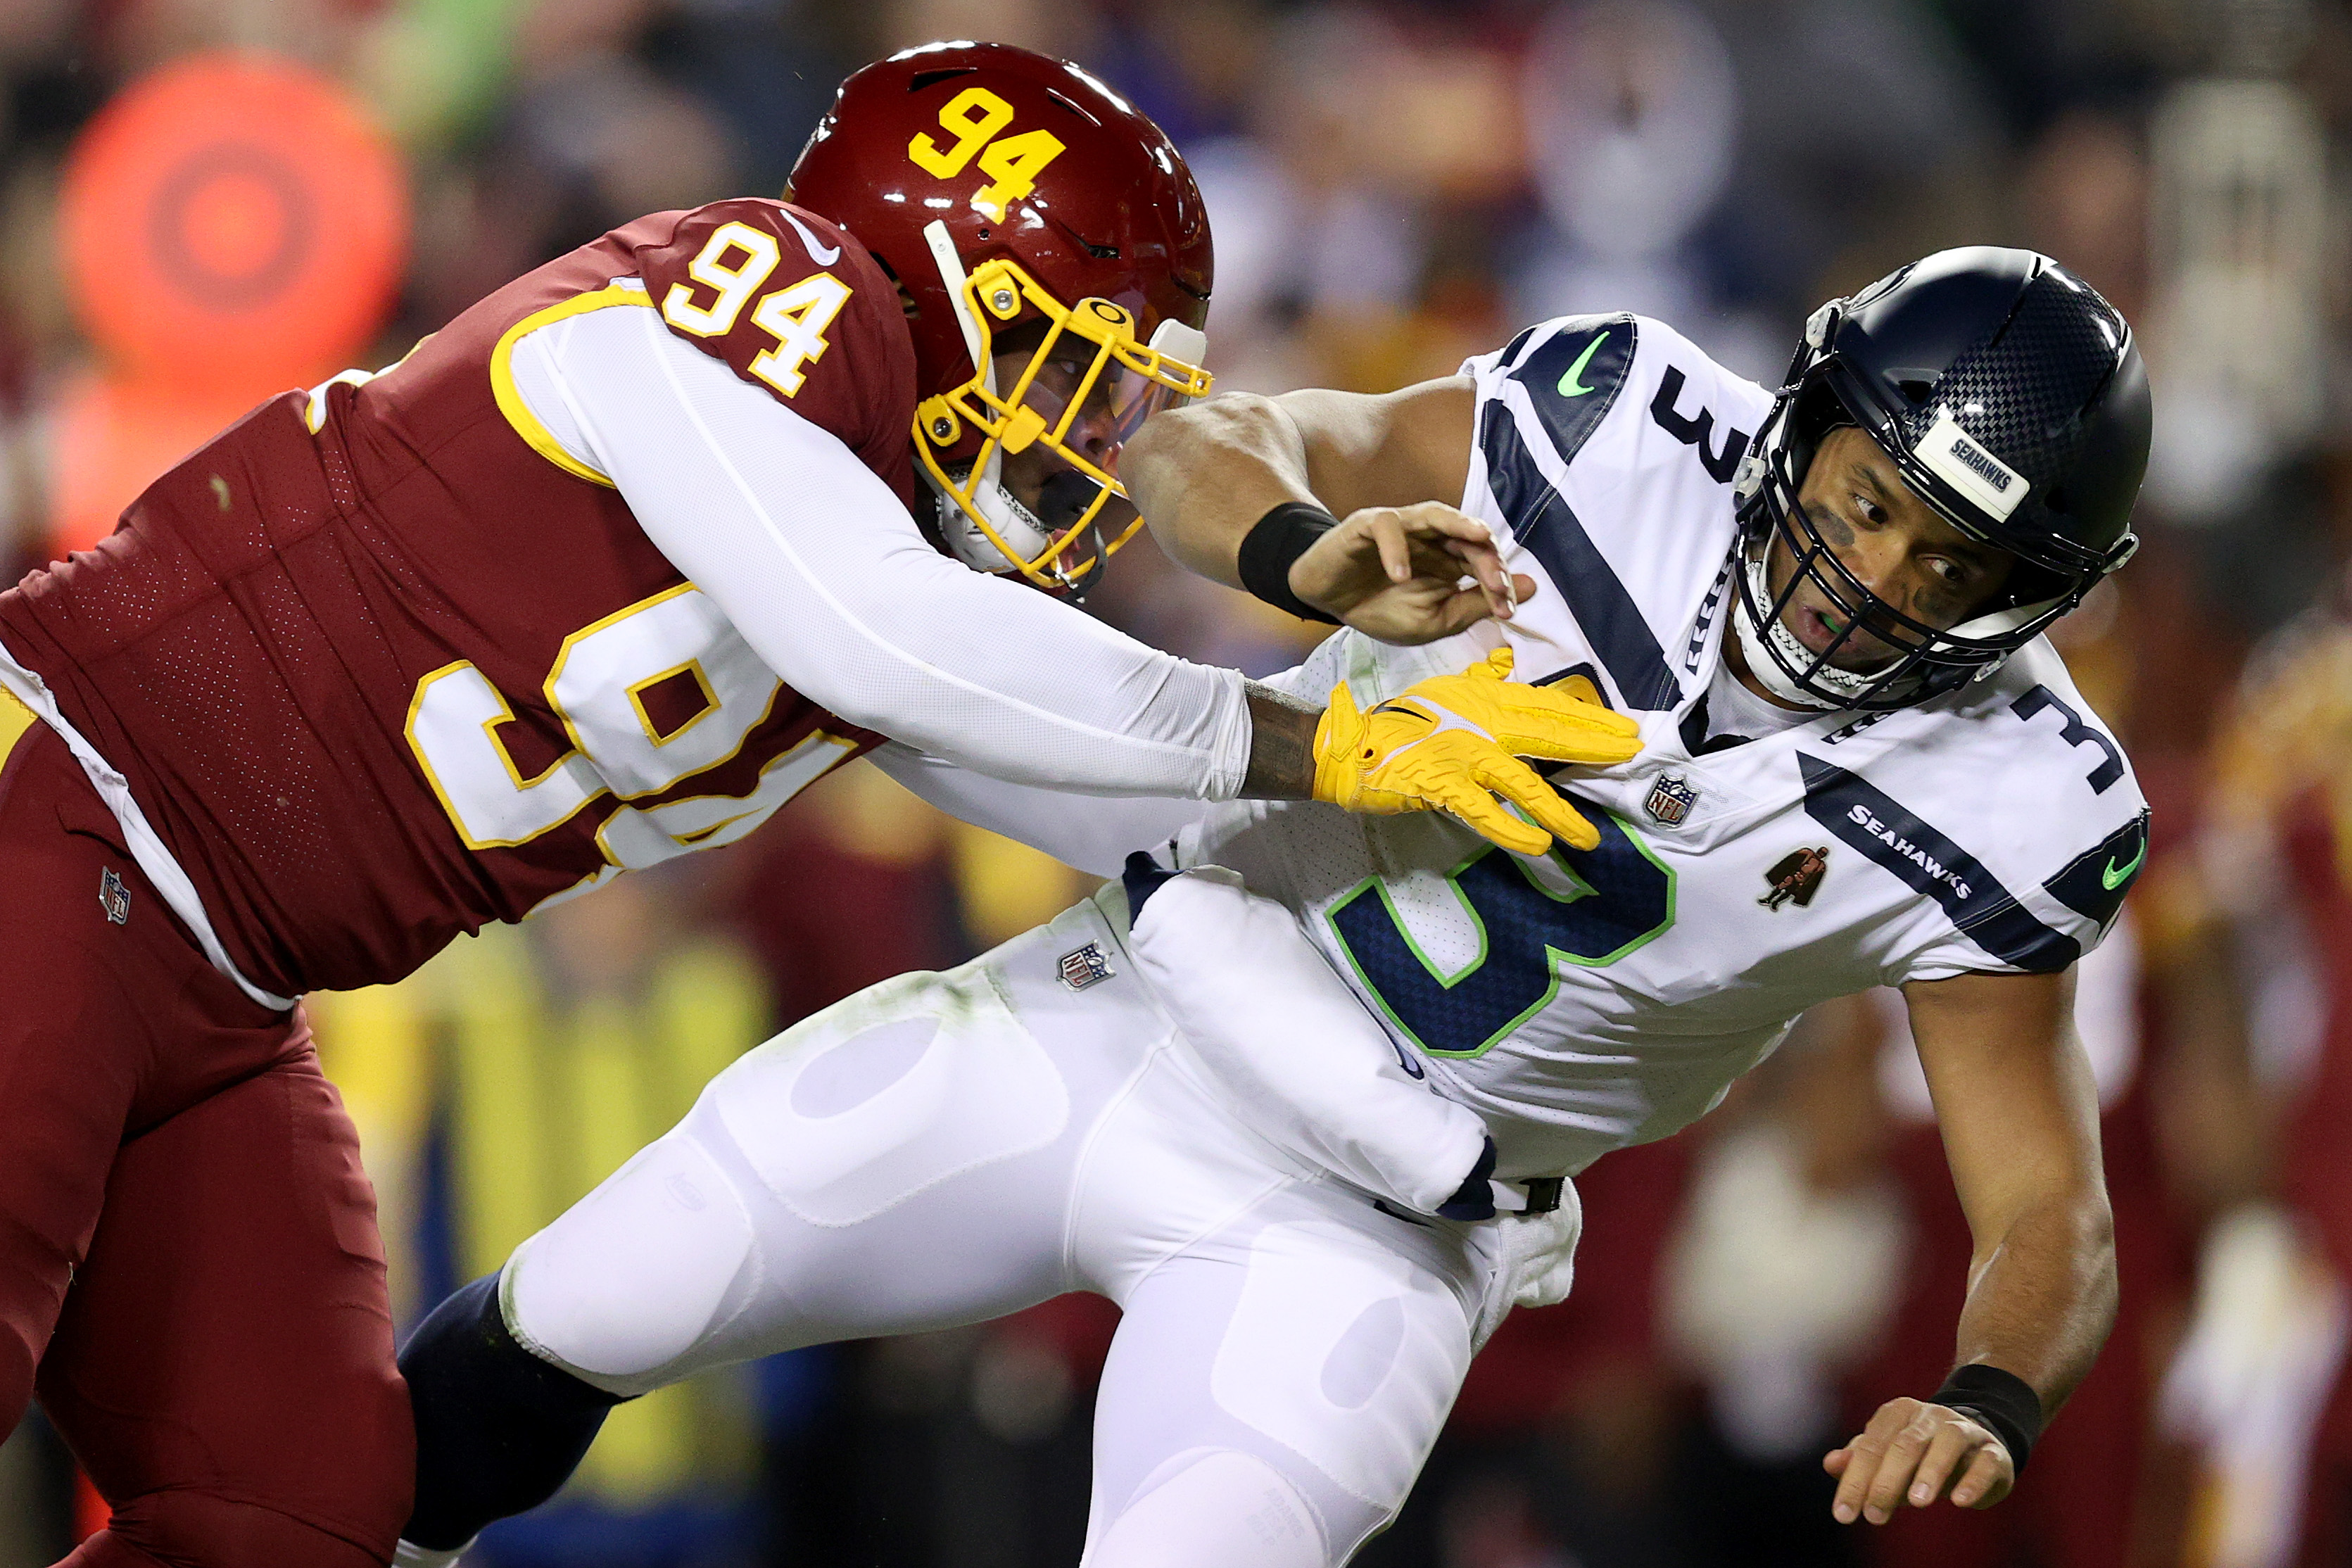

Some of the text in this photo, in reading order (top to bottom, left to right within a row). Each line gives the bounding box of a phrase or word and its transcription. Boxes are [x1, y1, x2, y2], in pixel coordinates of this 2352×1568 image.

[909, 87, 1067, 225] 94
[662, 220, 853, 399] 94
[1650, 364, 1748, 484] 3
[1949, 438, 2013, 493] SEAHAWKS
[2009, 683, 2125, 796] 3
[1648, 792, 1684, 821] NFL
[1846, 804, 1973, 900] SEAHAWKS
[104, 884, 126, 918] NFL
[1322, 777, 1677, 1058] 3
[1063, 954, 1092, 985] NFL
